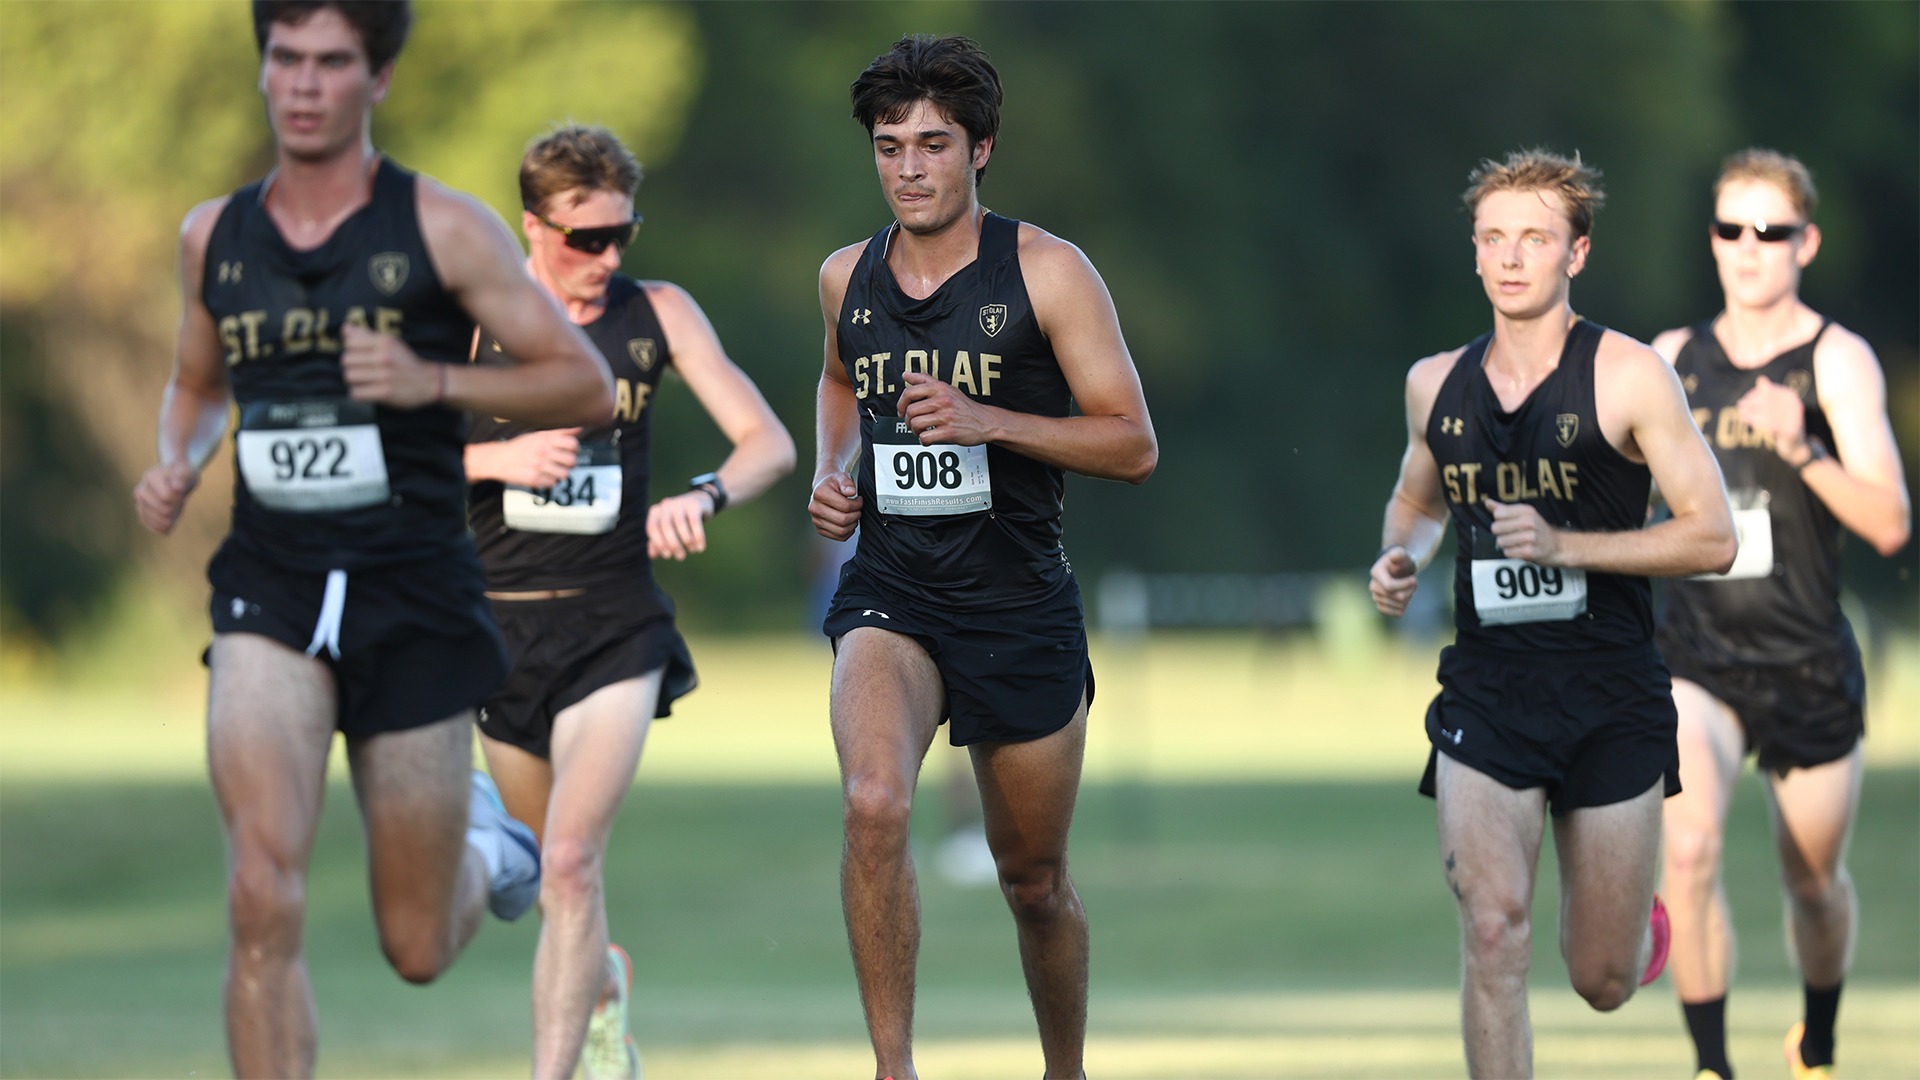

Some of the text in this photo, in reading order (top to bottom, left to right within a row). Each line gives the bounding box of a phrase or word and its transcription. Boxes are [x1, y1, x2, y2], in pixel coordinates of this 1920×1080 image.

[219, 309, 274, 366] ST.
[855, 352, 896, 399] ST.
[612, 377, 652, 423] AF
[271, 438, 352, 480] 922
[893, 451, 962, 490] 908
[1443, 458, 1579, 504] ST. OLAF
[1495, 565, 1563, 599] 909
